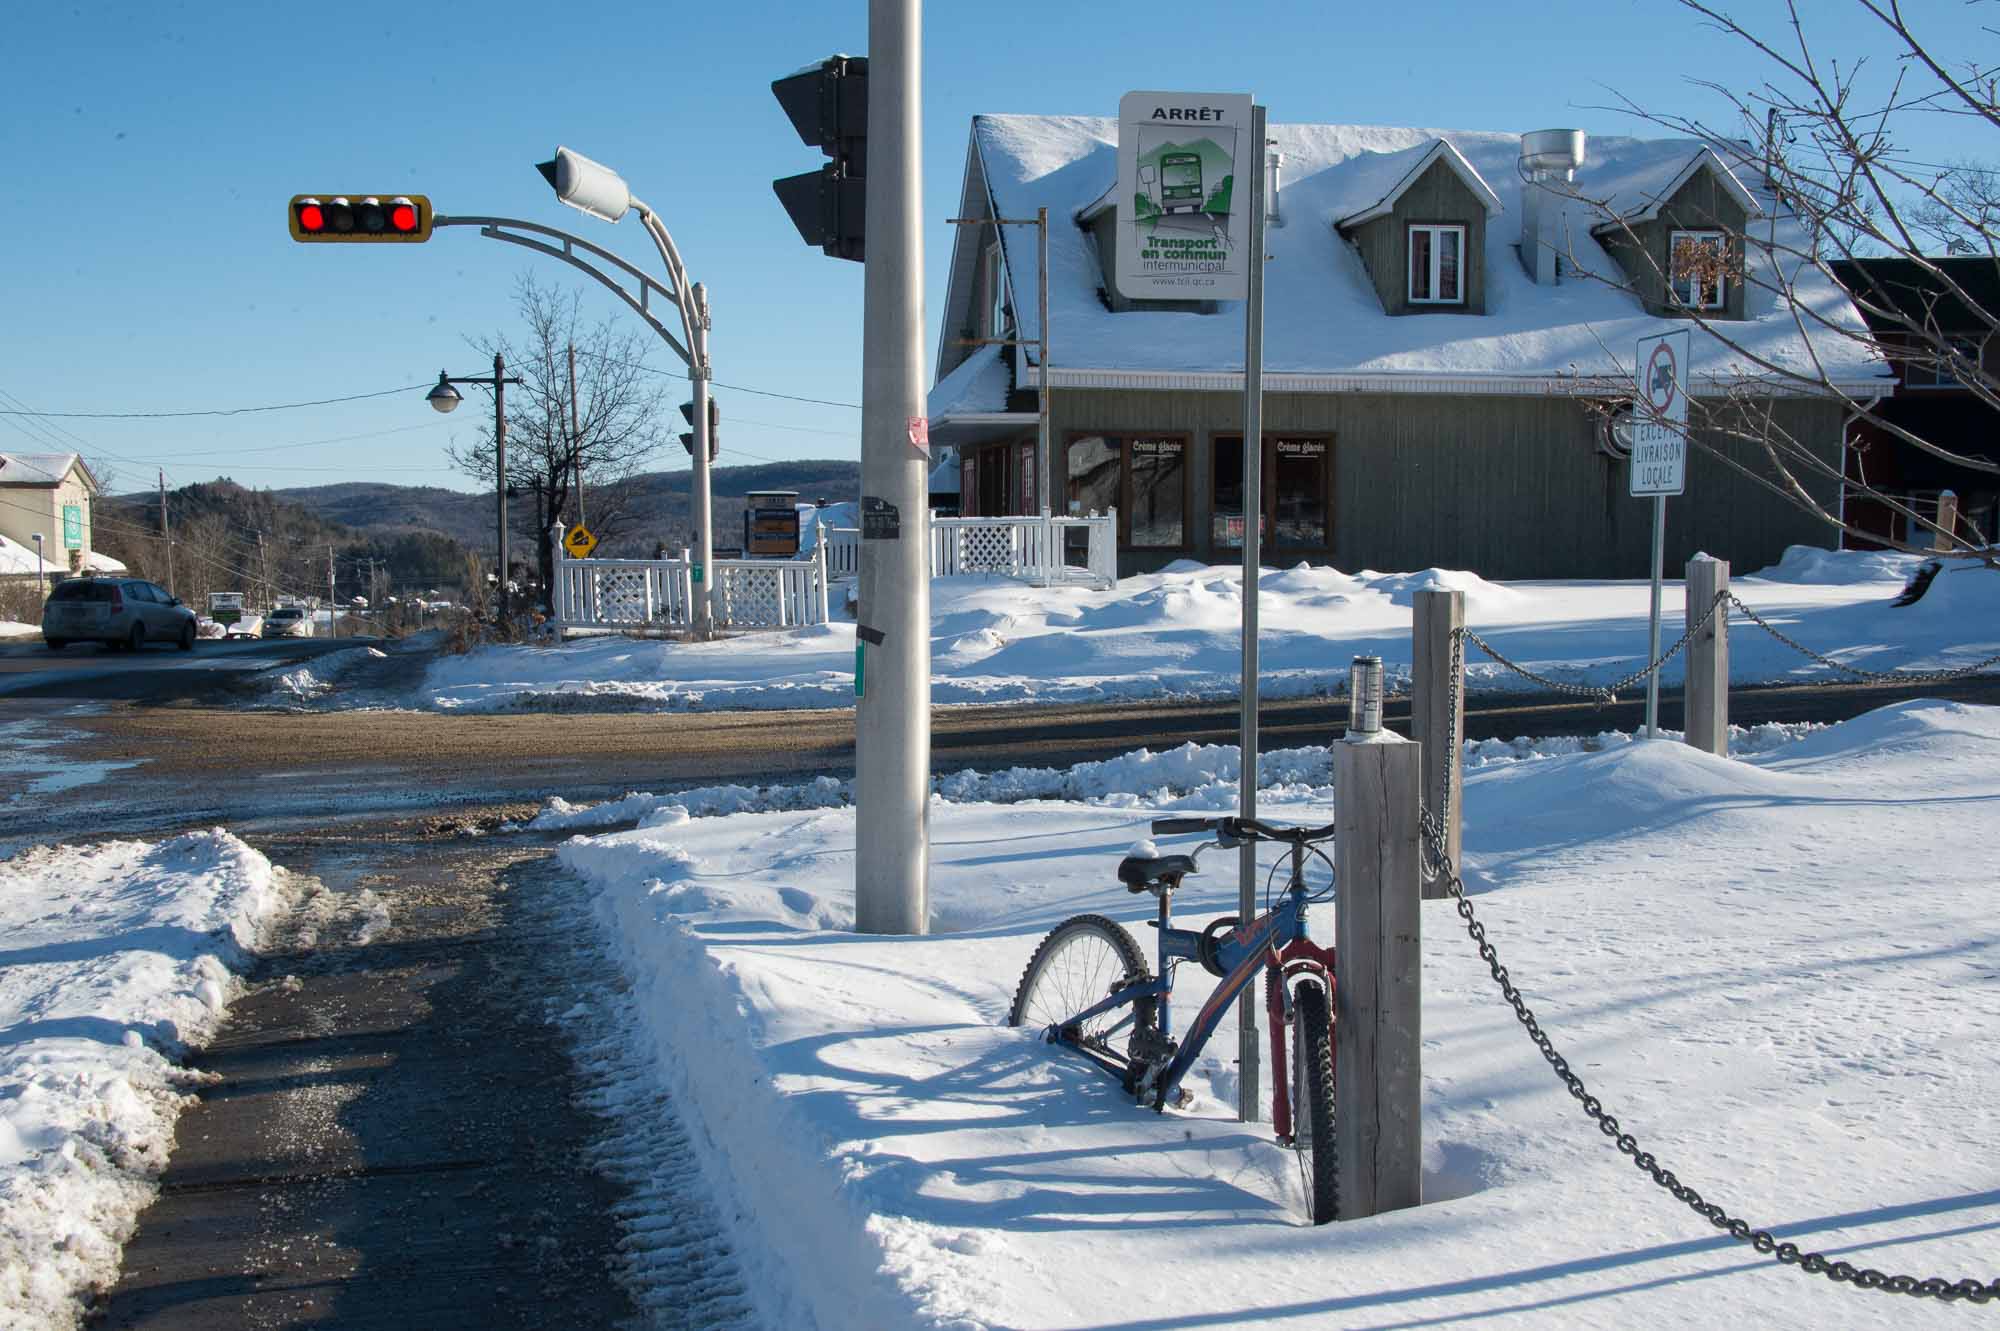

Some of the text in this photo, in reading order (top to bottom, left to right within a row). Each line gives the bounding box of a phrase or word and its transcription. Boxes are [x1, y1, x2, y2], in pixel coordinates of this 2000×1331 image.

[1152, 106, 1225, 121] ARRÊT
[1146, 236, 1217, 250] Transport
[1141, 249, 1227, 260] en commun
[1143, 260, 1225, 273] intermunicipal
[1636, 443, 1681, 464] LIVRAISON
[1642, 465, 1673, 485] LOCALE
